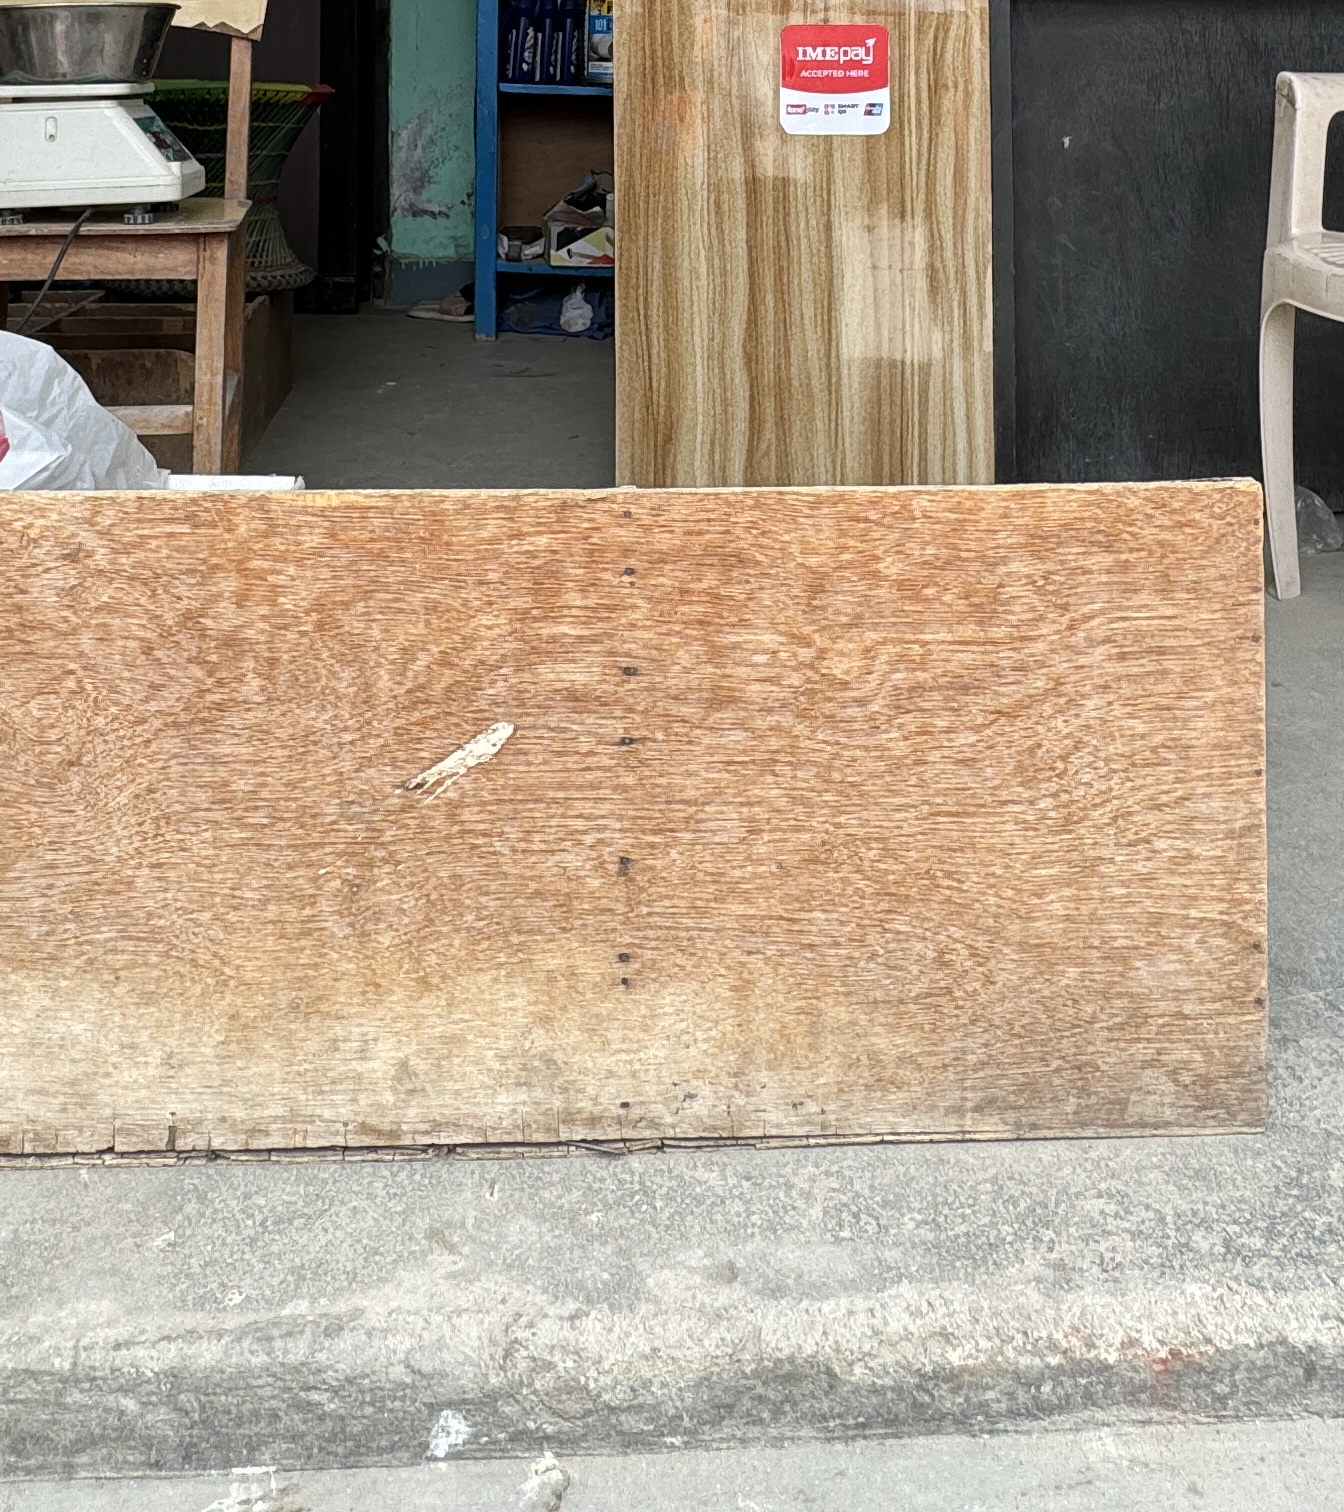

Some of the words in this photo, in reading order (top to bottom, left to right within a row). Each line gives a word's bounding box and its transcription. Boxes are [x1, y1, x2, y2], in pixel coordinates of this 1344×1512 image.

[796, 38, 876, 64] IMEpay
[800, 69, 845, 78] ACCEPTED
[846, 69, 870, 78] HERE
